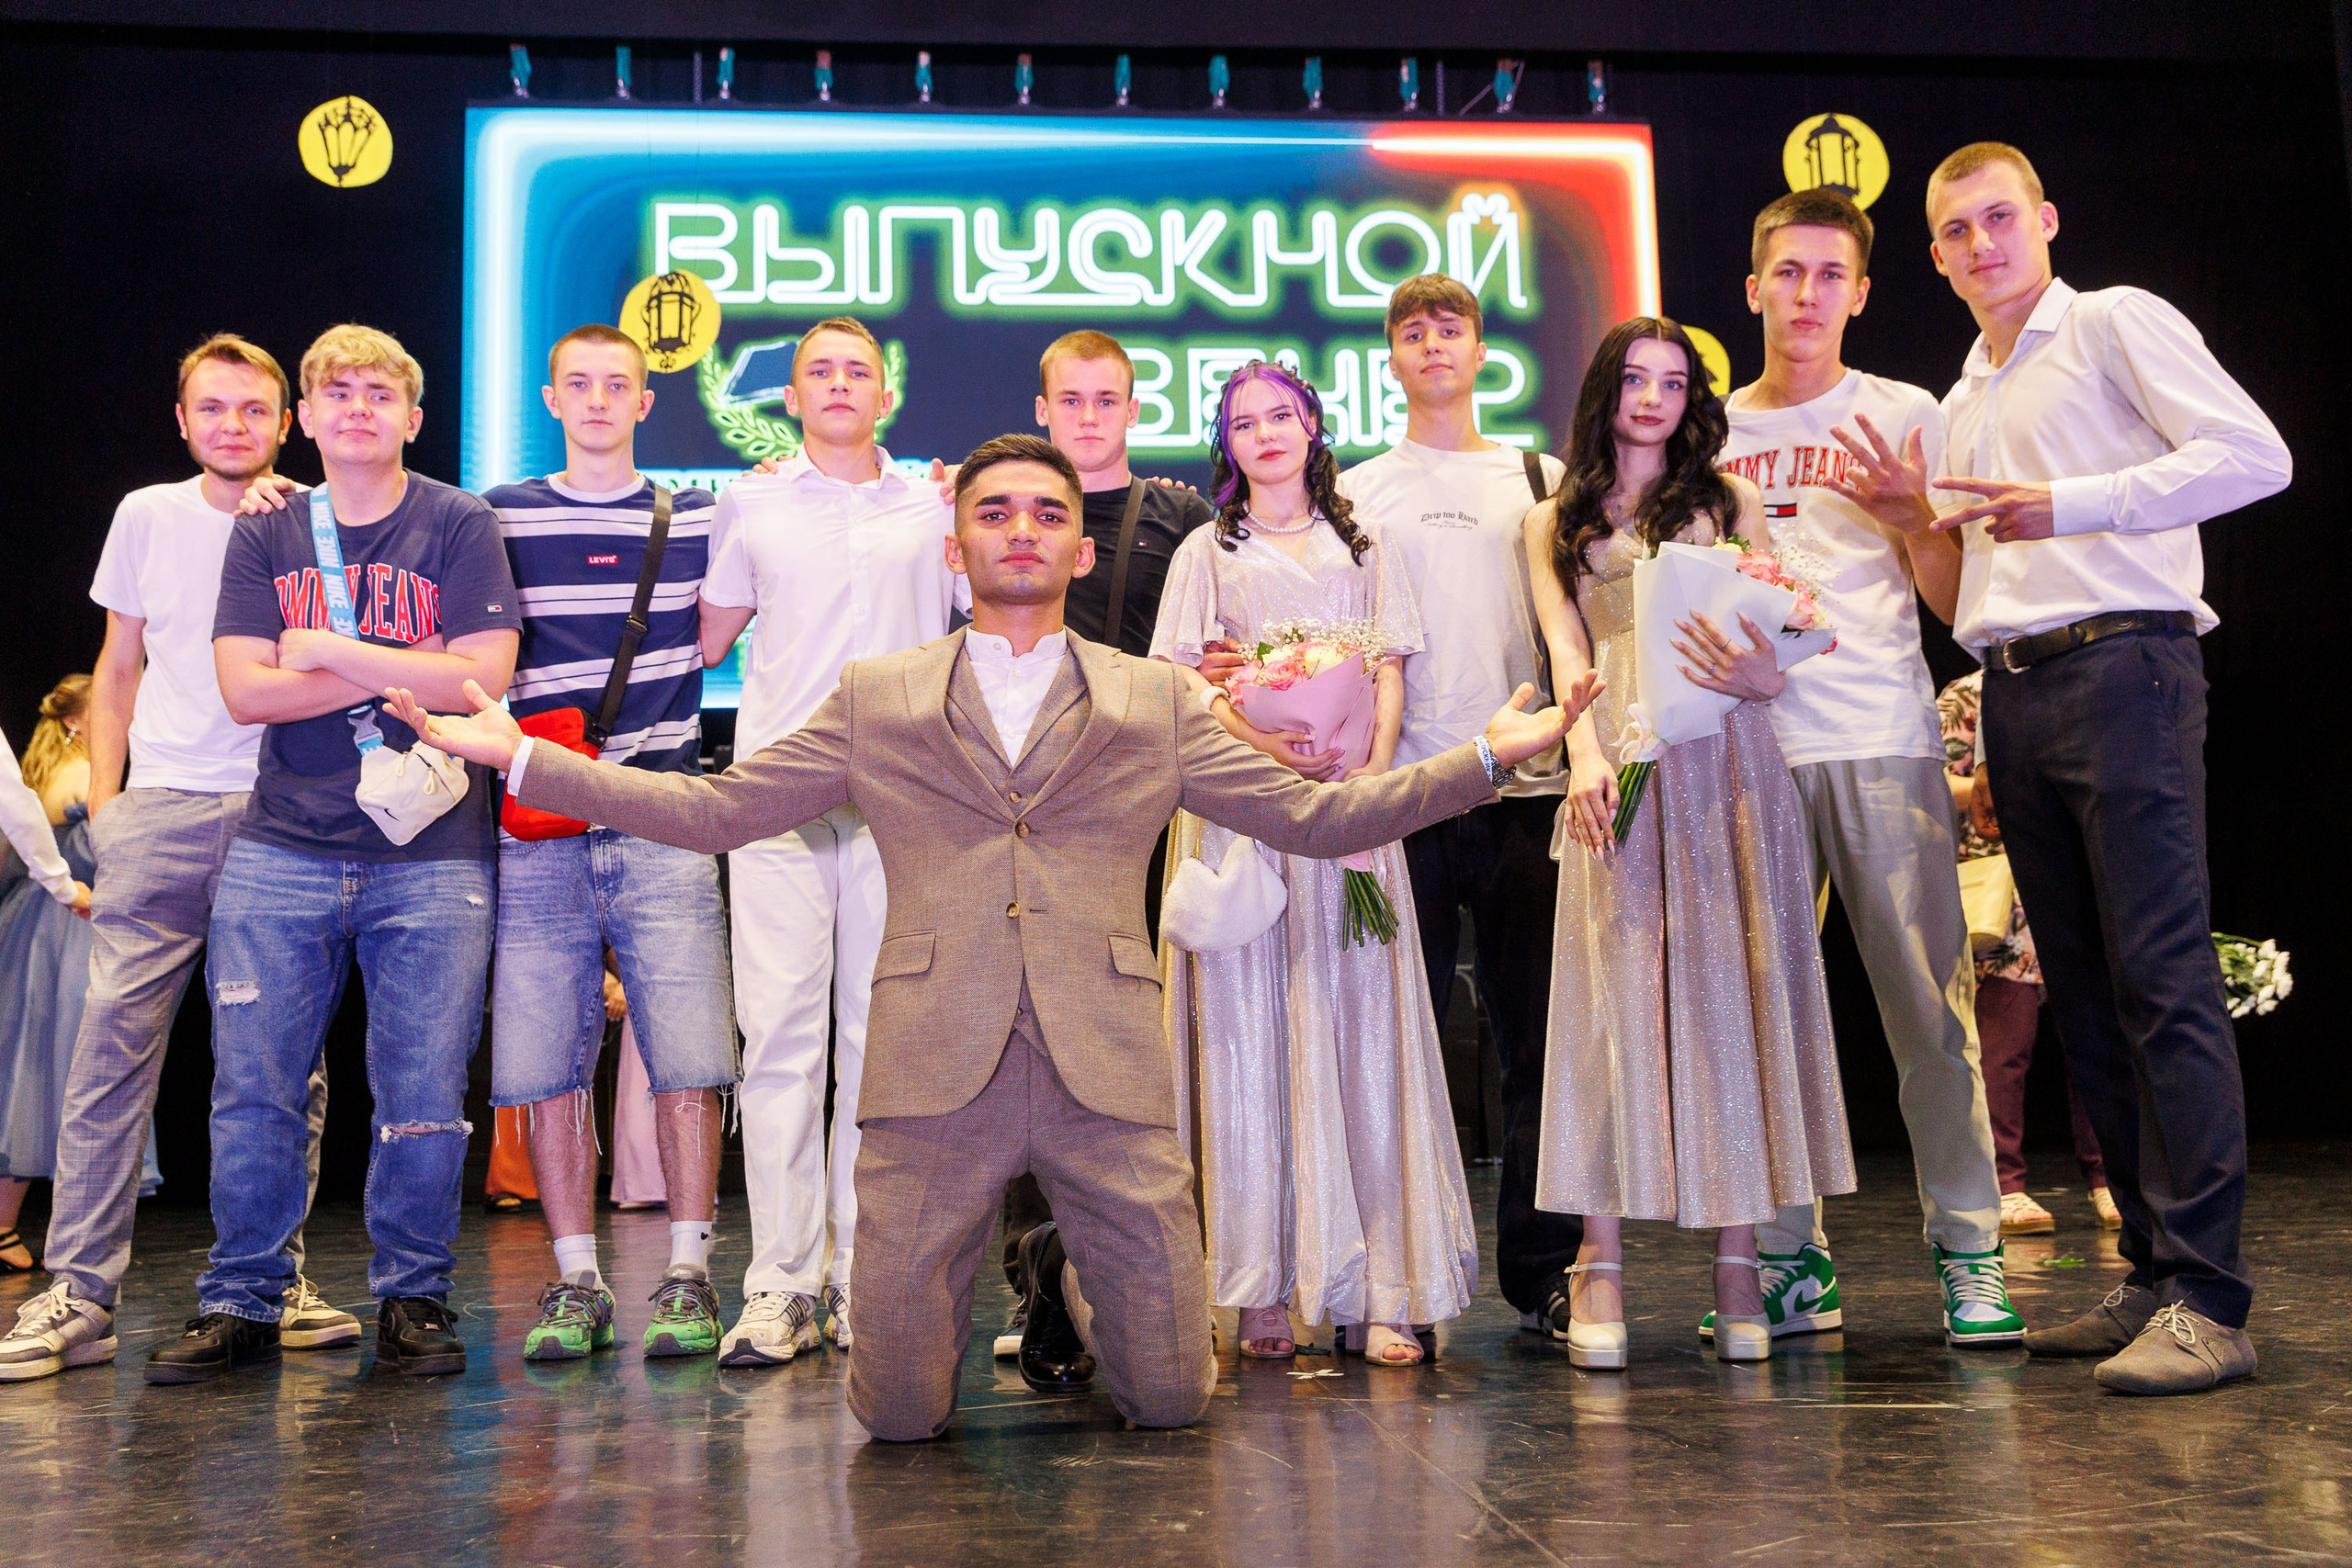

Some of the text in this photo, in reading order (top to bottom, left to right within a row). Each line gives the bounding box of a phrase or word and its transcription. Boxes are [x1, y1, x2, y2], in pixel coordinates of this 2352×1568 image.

[655, 193, 1528, 309] ВЫПУСКНОЙ
[311, 501, 333, 530] NIKE
[315, 536, 341, 569] NIKE
[322, 573, 350, 609] NIKE
